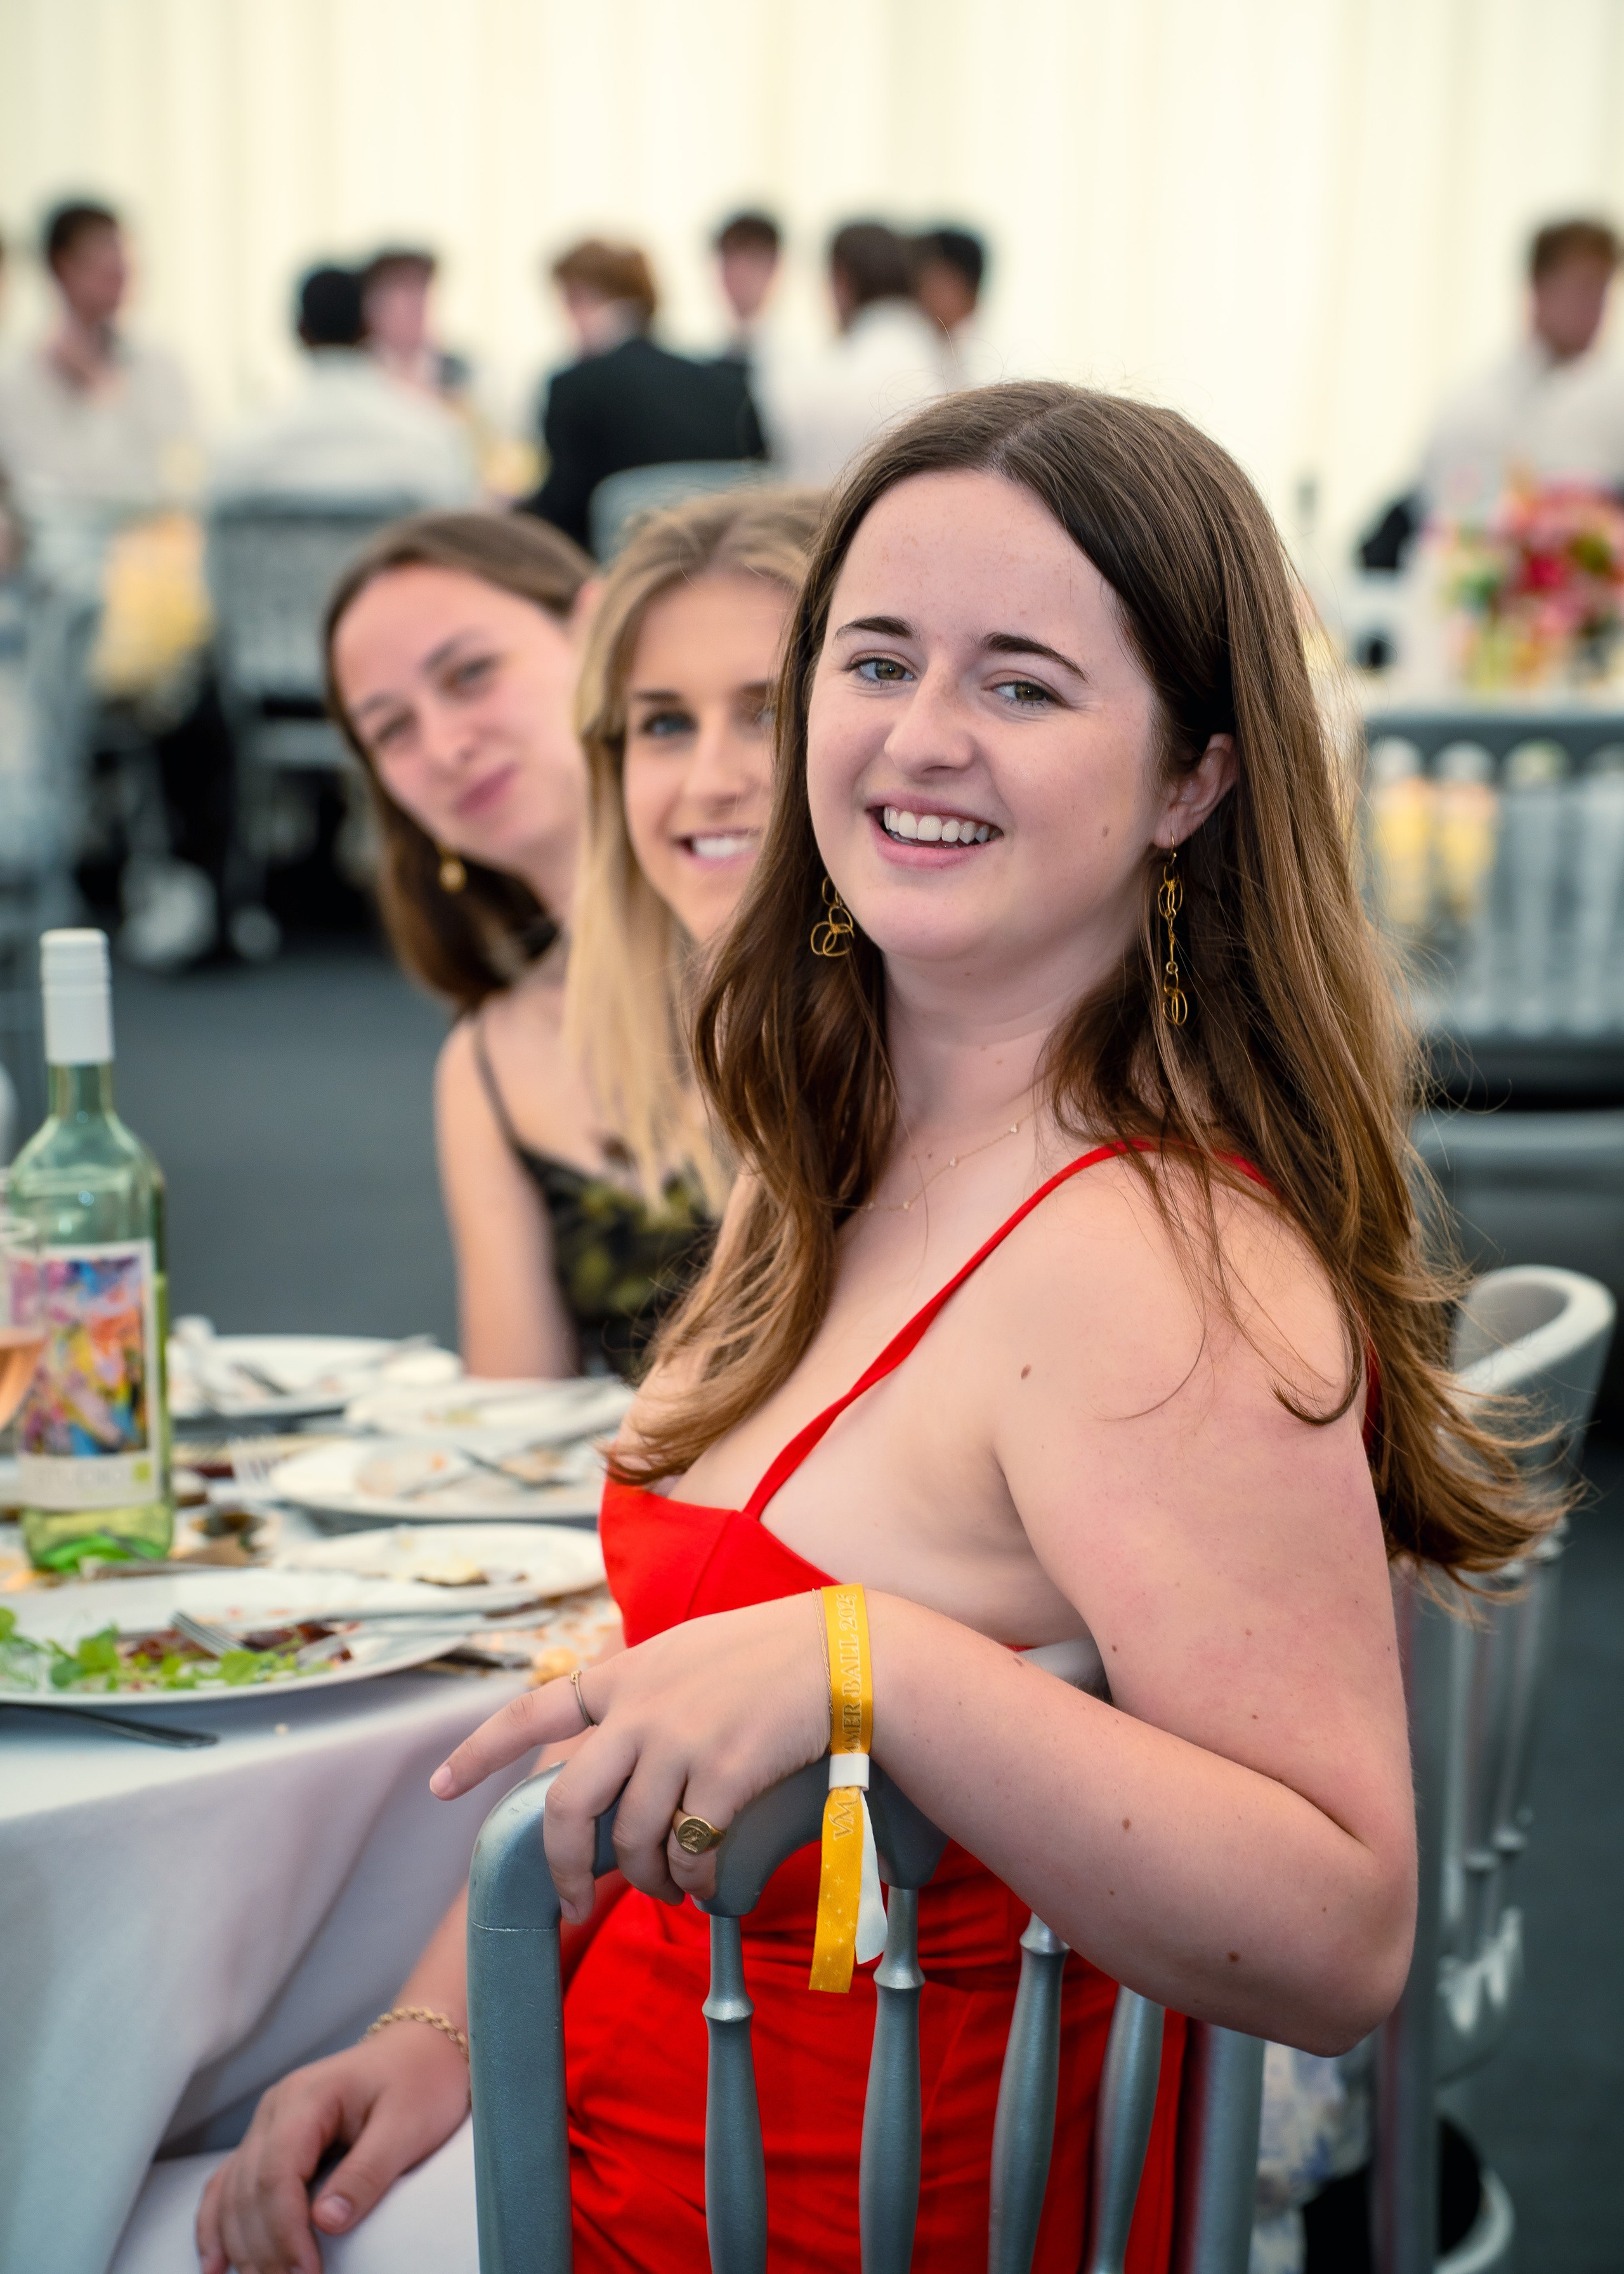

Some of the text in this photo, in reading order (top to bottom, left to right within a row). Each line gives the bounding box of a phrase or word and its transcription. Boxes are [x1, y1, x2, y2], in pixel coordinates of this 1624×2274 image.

[836, 1593, 858, 1631] 2025
[839, 1634, 861, 1698] BALL
[828, 1801, 858, 1841] VM
